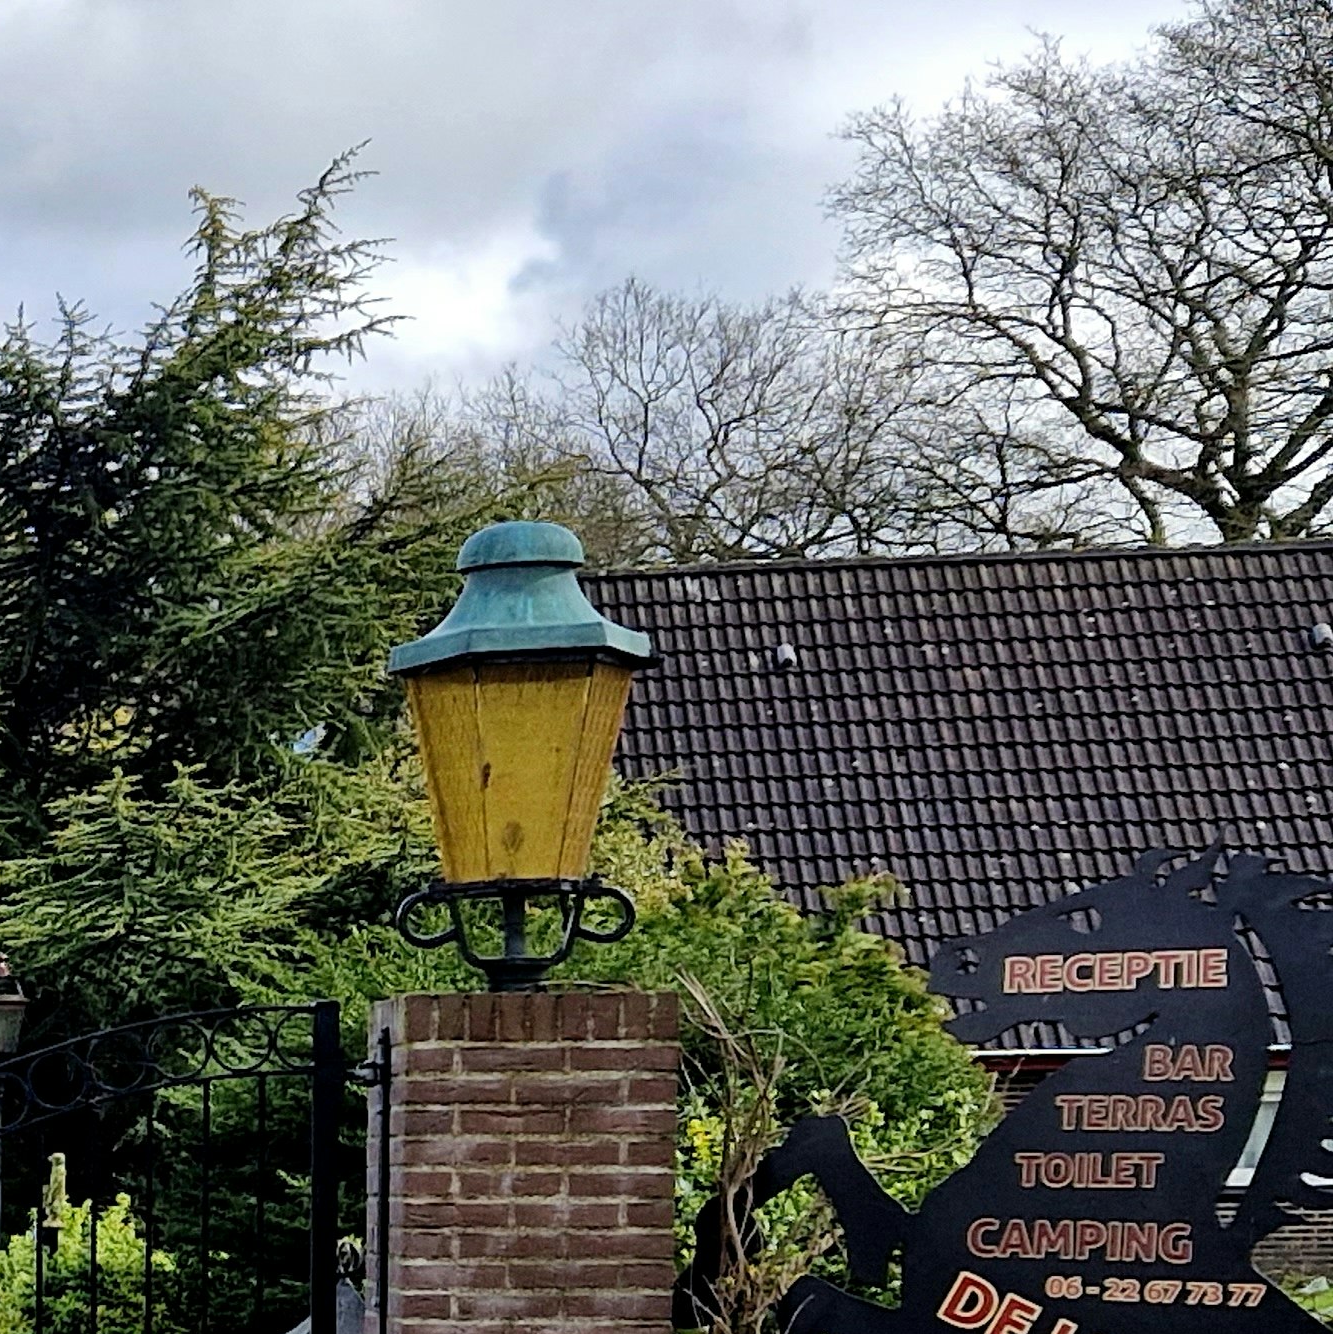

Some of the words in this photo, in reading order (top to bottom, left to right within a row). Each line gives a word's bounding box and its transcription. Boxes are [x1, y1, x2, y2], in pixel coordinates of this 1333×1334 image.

[1003, 948, 1228, 993] RECEPTIE
[1143, 1045, 1234, 1081] BAR
[1056, 1095, 1225, 1132] TERRAS
[1015, 1153, 1165, 1188] TOILET
[967, 1218, 1192, 1264] CAMPING
[1045, 1276, 1083, 1299] 06
[1102, 1278, 1140, 1302] 22
[1143, 1280, 1182, 1304] 67
[1185, 1281, 1223, 1306] 73
[1228, 1283, 1267, 1307] 77
